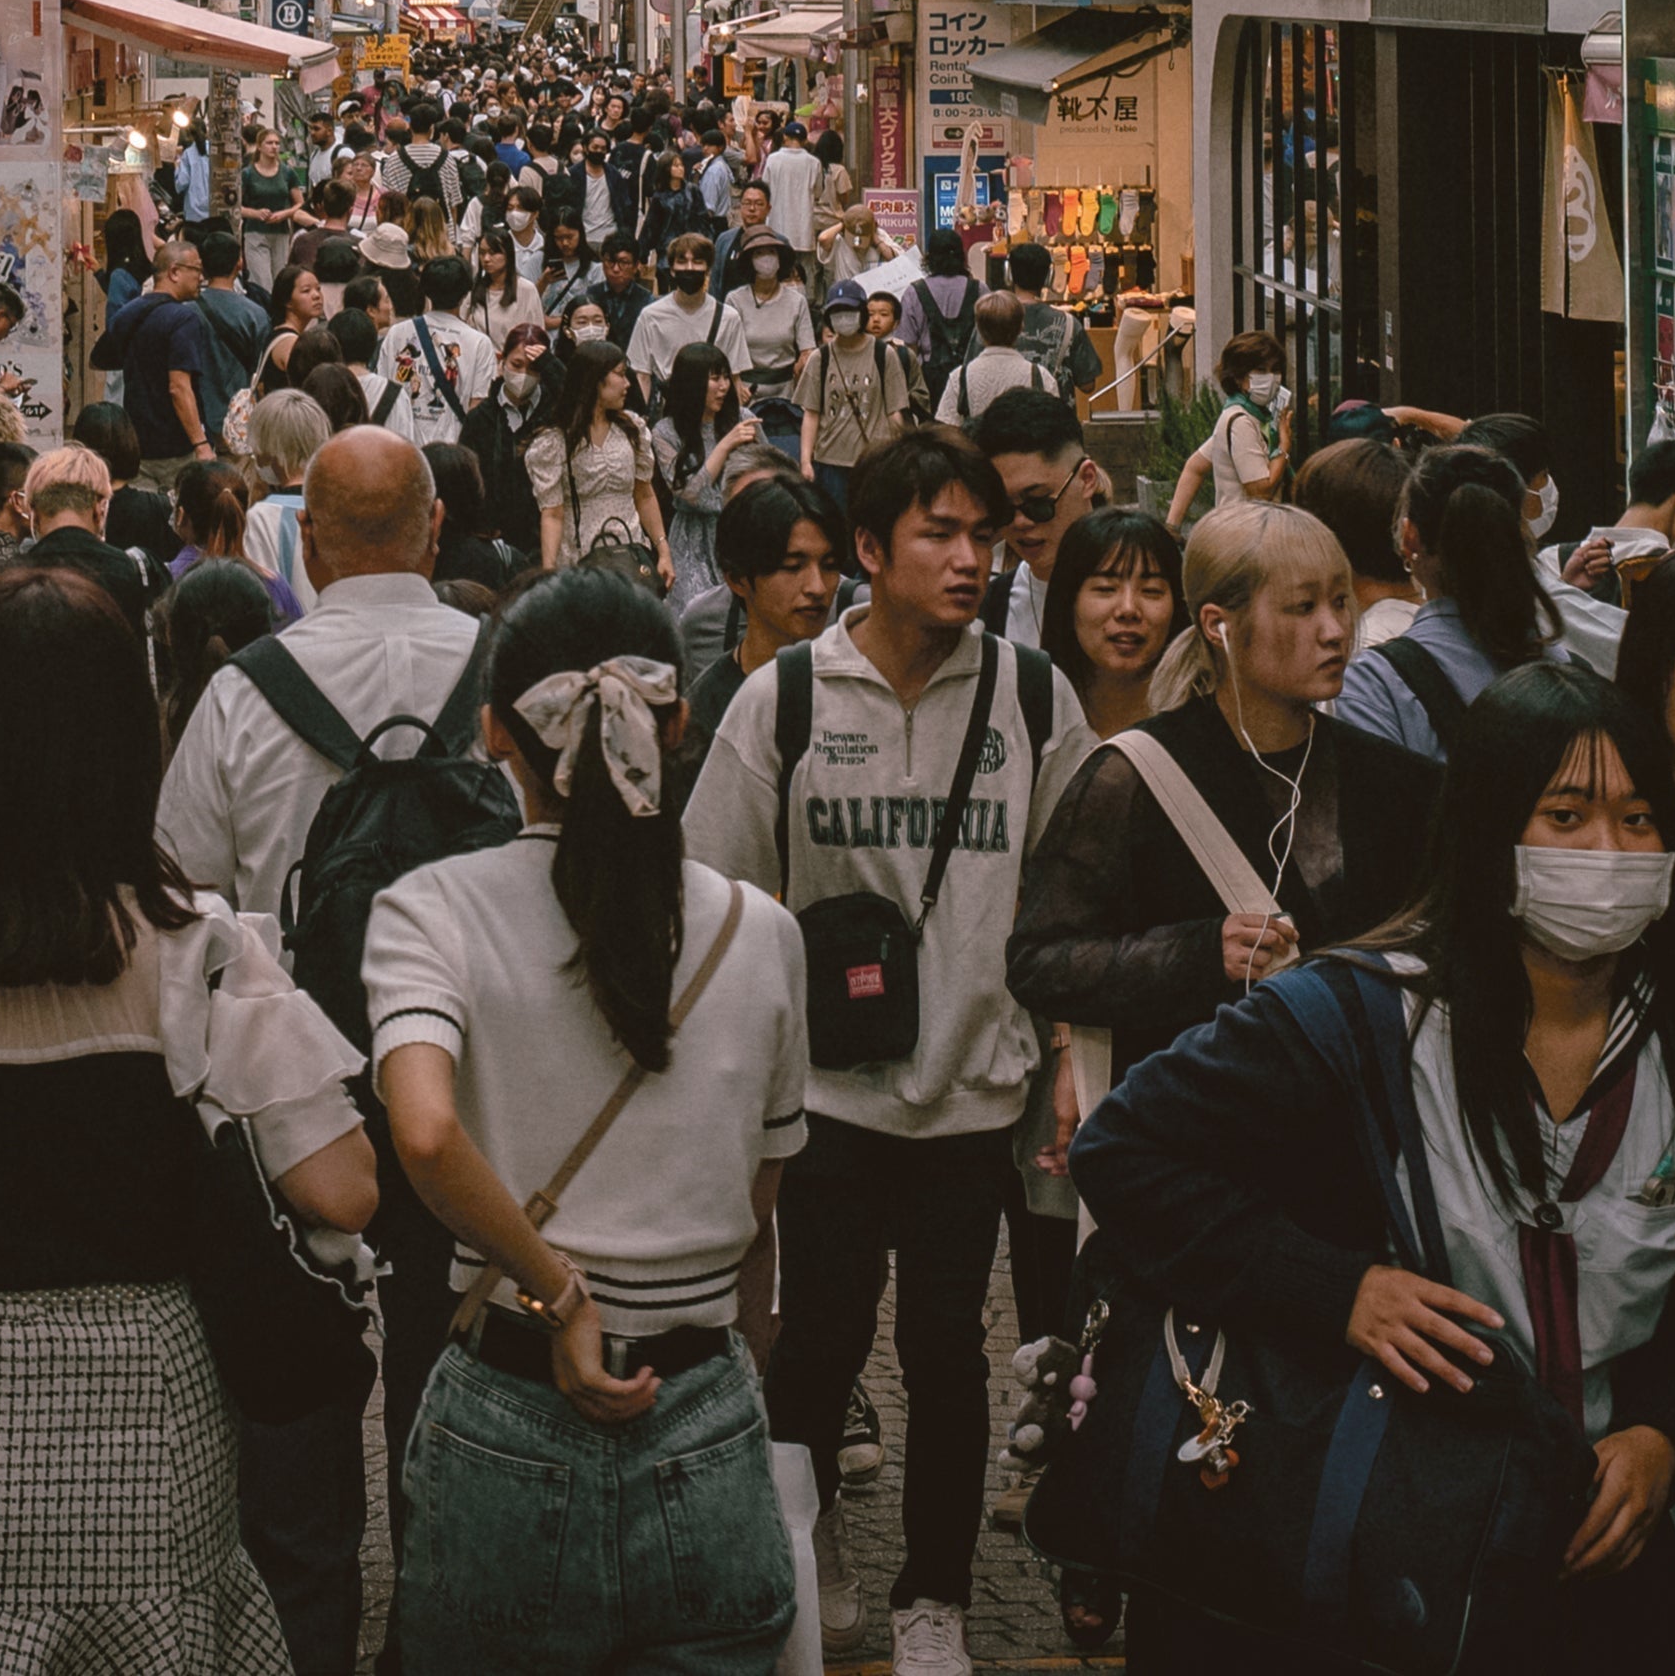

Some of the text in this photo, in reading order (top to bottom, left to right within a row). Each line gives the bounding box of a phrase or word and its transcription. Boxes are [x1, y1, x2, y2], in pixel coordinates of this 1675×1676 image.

[929, 12, 987, 32] コイン
[929, 36, 1005, 56] ロッカー
[930, 74, 959, 85] Coin
[823, 731, 868, 743] Beware
[814, 742, 879, 757] Regulation
